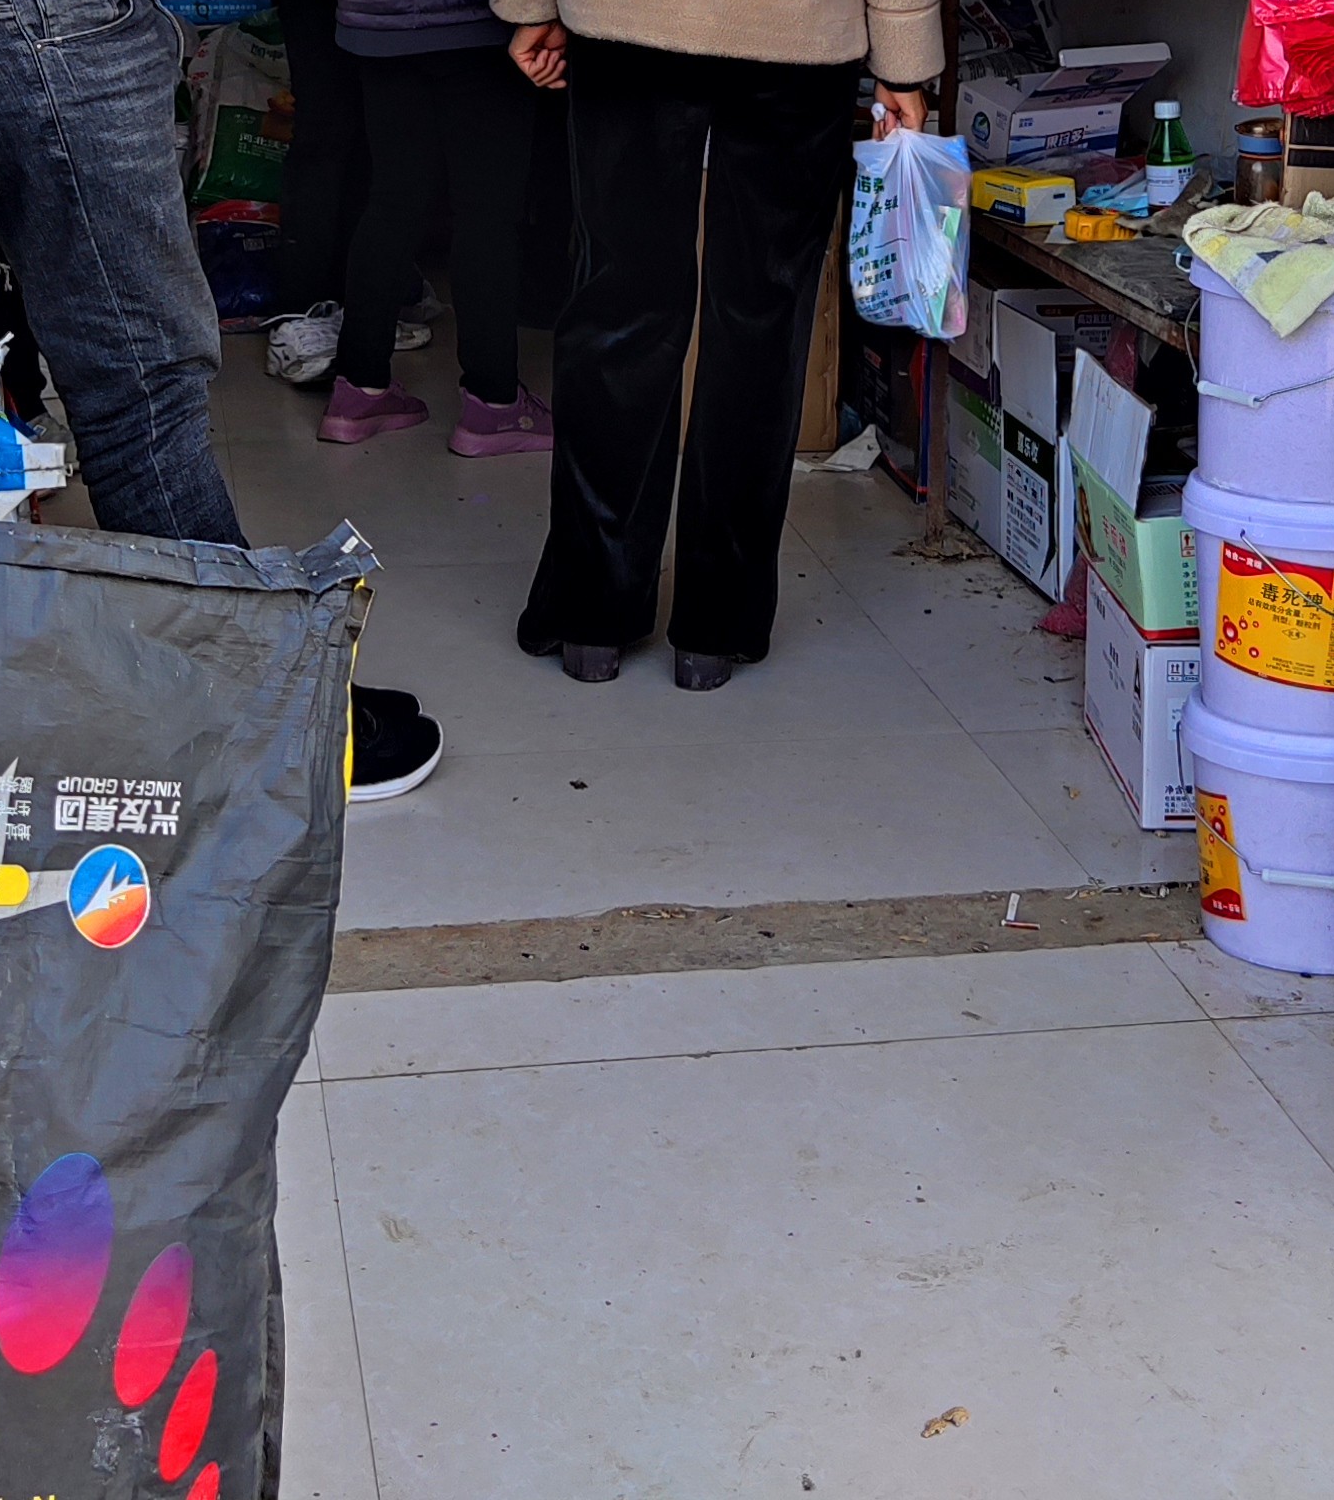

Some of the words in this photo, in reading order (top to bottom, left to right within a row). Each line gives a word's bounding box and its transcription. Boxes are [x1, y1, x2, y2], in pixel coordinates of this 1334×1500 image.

[1261, 582, 1324, 612] 毒死蜱
[57, 775, 119, 796] GROUP
[122, 778, 182, 799] XINGFA
[54, 794, 181, 836] 兴发集团
